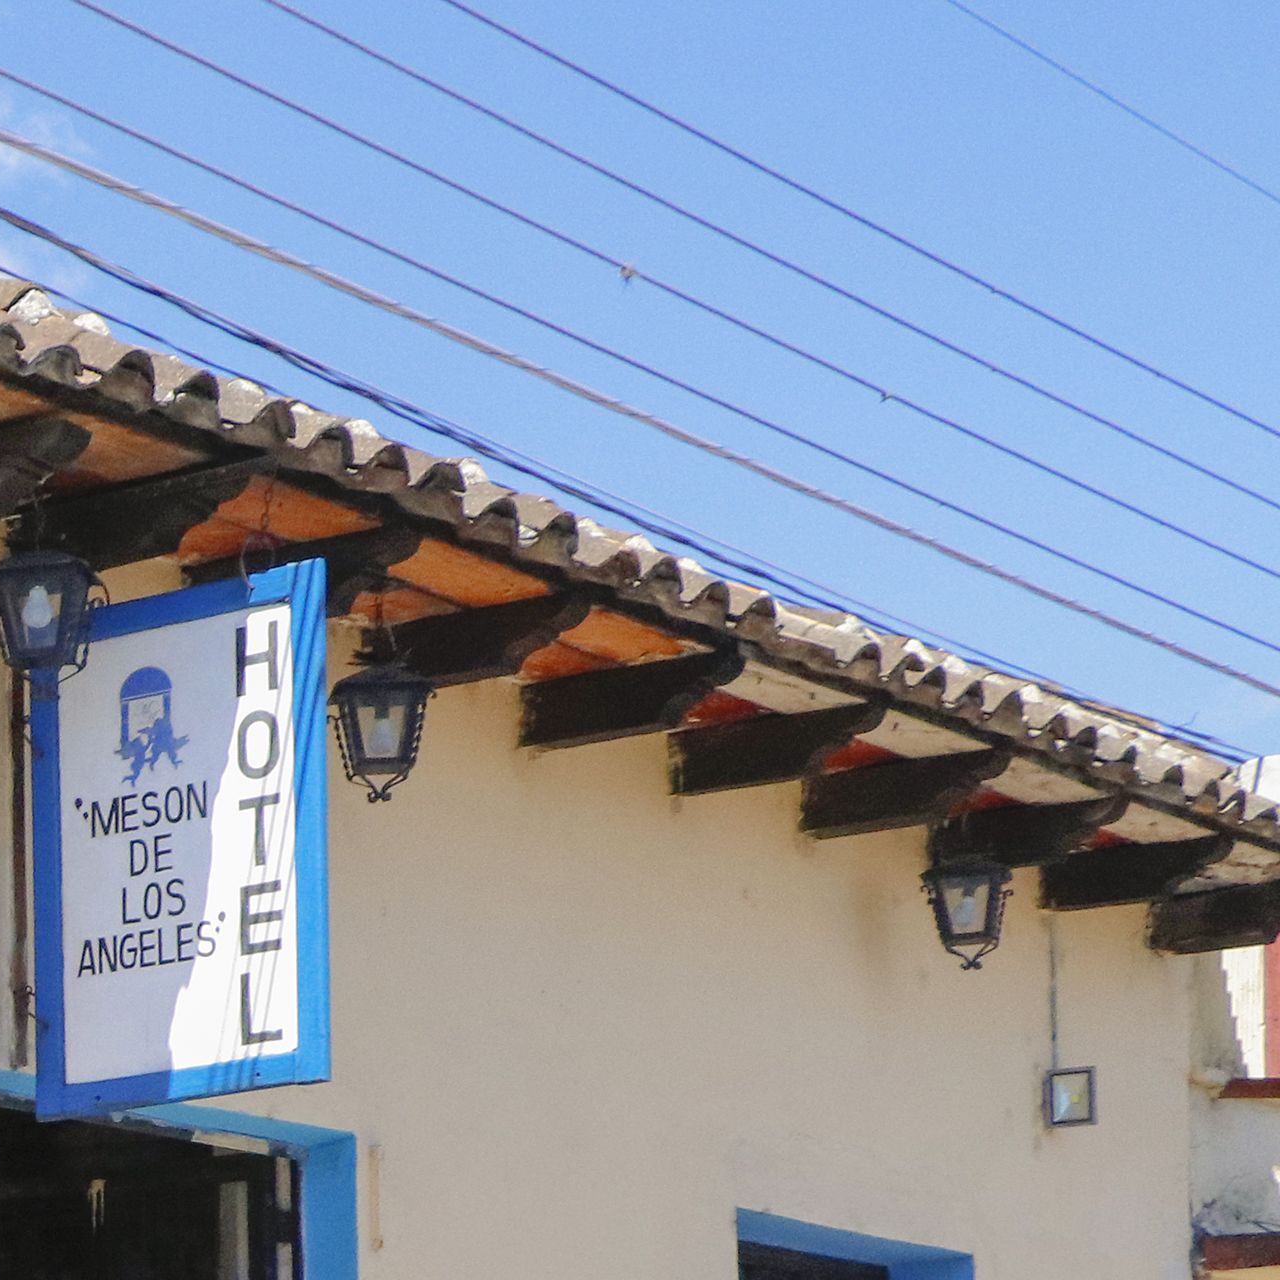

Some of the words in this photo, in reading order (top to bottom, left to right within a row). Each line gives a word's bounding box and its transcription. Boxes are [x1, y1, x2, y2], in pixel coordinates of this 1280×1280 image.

[130, 833, 173, 876] DE
[236, 620, 283, 1046] HOTEL
[122, 878, 186, 925] LOS
